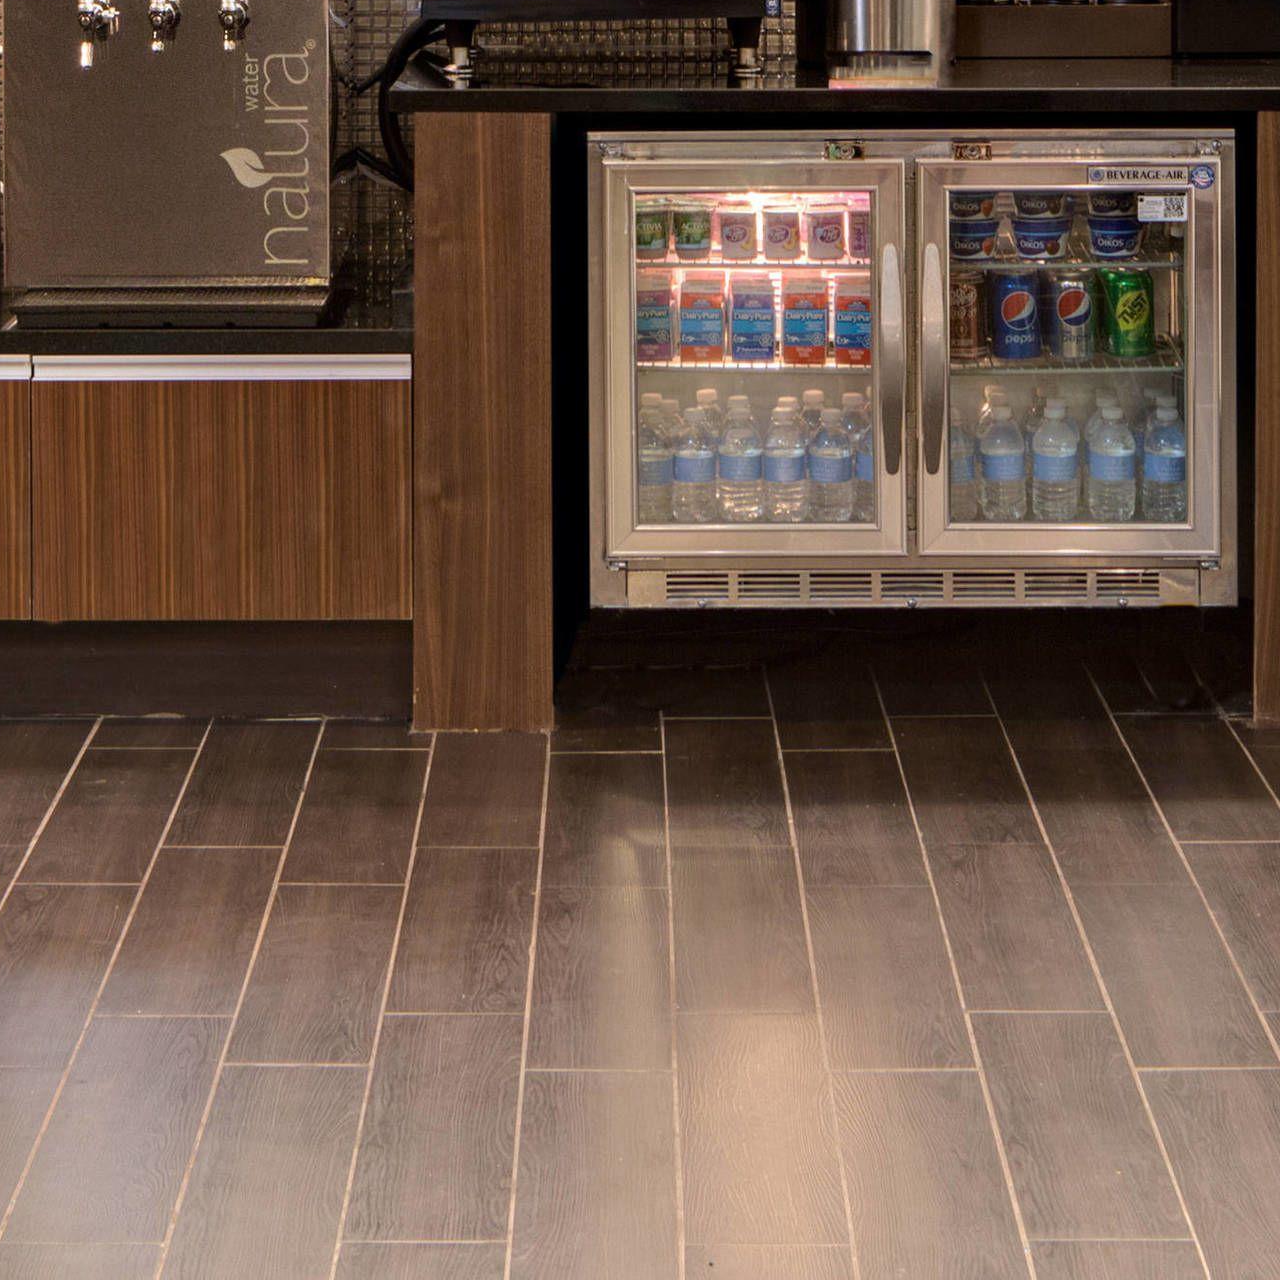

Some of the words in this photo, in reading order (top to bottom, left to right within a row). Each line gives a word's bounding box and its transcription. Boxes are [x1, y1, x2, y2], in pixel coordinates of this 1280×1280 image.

[243, 52, 260, 112] water
[1019, 239, 1045, 250] OIKOS
[1097, 238, 1124, 248] OIKOS
